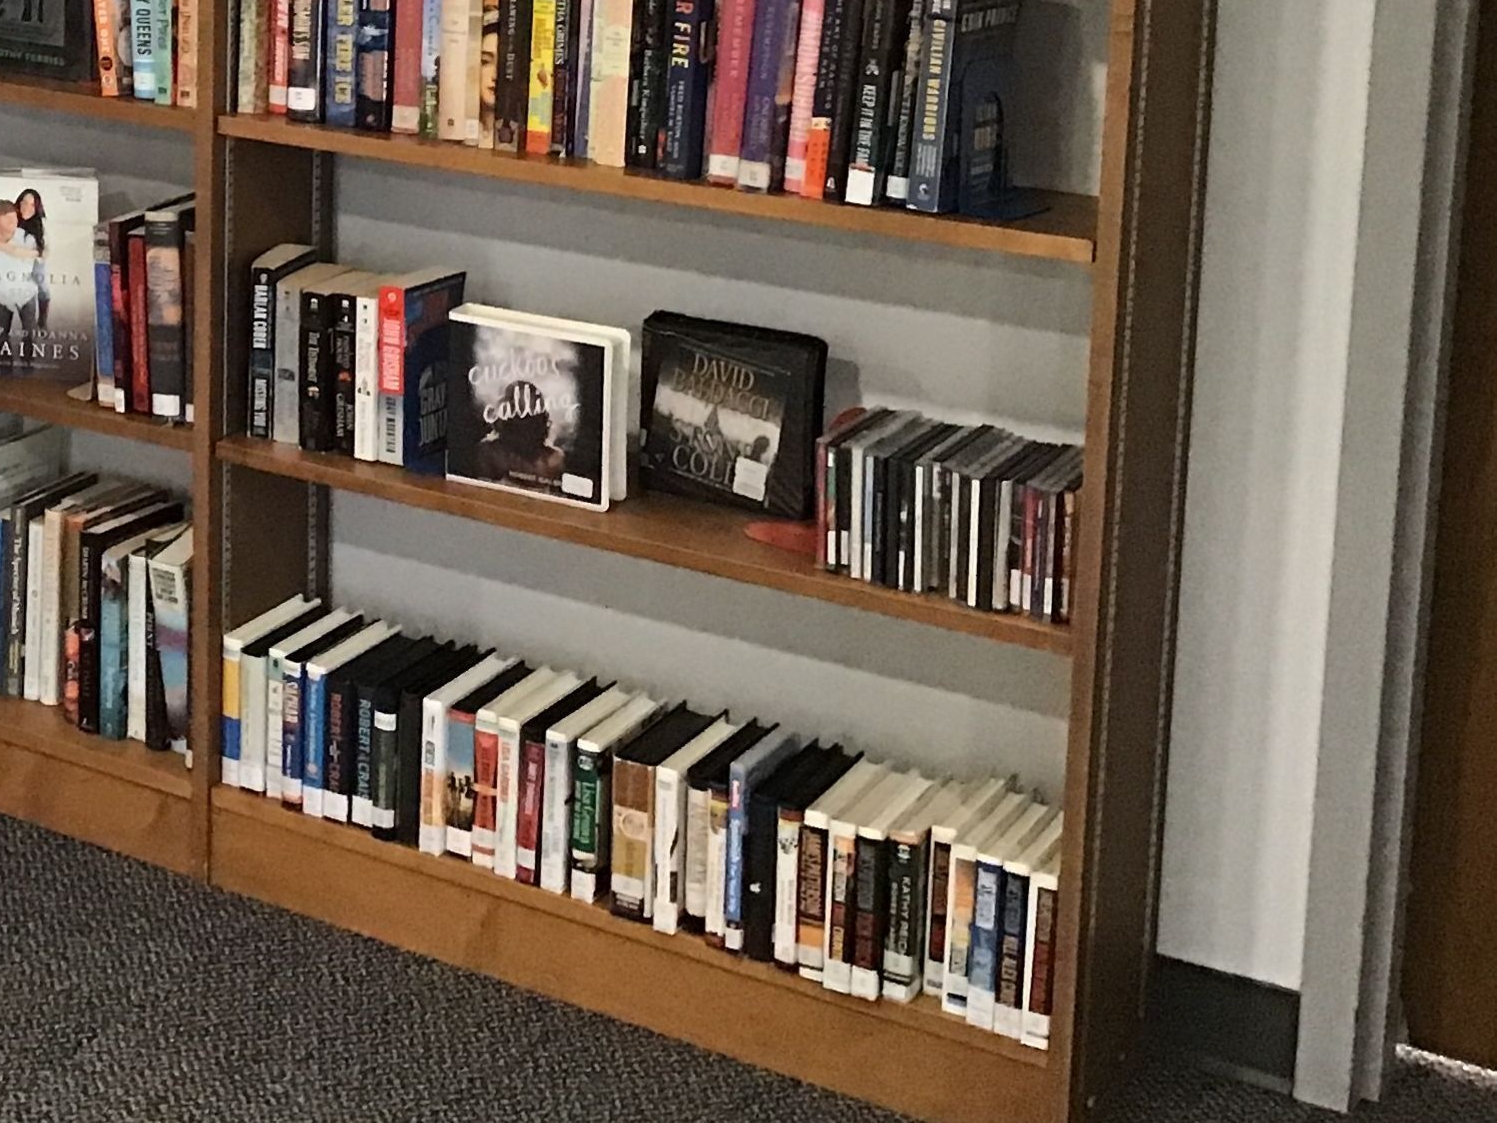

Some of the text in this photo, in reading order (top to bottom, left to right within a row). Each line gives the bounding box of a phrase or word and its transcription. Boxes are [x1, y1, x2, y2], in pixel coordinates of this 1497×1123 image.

[100, 29, 109, 53] ONE
[136, 9, 151, 55] QUEENS
[555, 25, 565, 65] GRIMES
[671, 22, 691, 69] FIRE
[823, 25, 831, 49] THE
[833, 19, 841, 40] ART
[929, 19, 946, 74] CIVILIAN
[335, 34, 353, 71] FIRE
[506, 53, 516, 82] DUST
[831, 45, 838, 59] OF
[334, 75, 352, 104] ICE
[819, 65, 829, 89] RAIN
[824, 64, 836, 110] RACING
[858, 84, 876, 146] KEEP IT IN THE
[922, 78, 940, 140] WARRIORS
[32, 328, 88, 342] JOANNA
[253, 285, 268, 427] HARLAN COBEN MISSING YOU
[383, 319, 400, 453] JOHN GRISHAM GRAY MOUNTAIN
[671, 366, 771, 419] BALDACCI
[693, 352, 754, 391] DAVID
[336, 393, 344, 437] GRISHAM
[483, 384, 581, 426] calling
[671, 445, 735, 485] COL
[10, 538, 22, 635] The Specter of Munich
[329, 692, 342, 793] ROBERT CRAI
[358, 699, 370, 752] ROBERT
[729, 818, 741, 863] Spanish
[900, 876, 911, 919] KATHY
